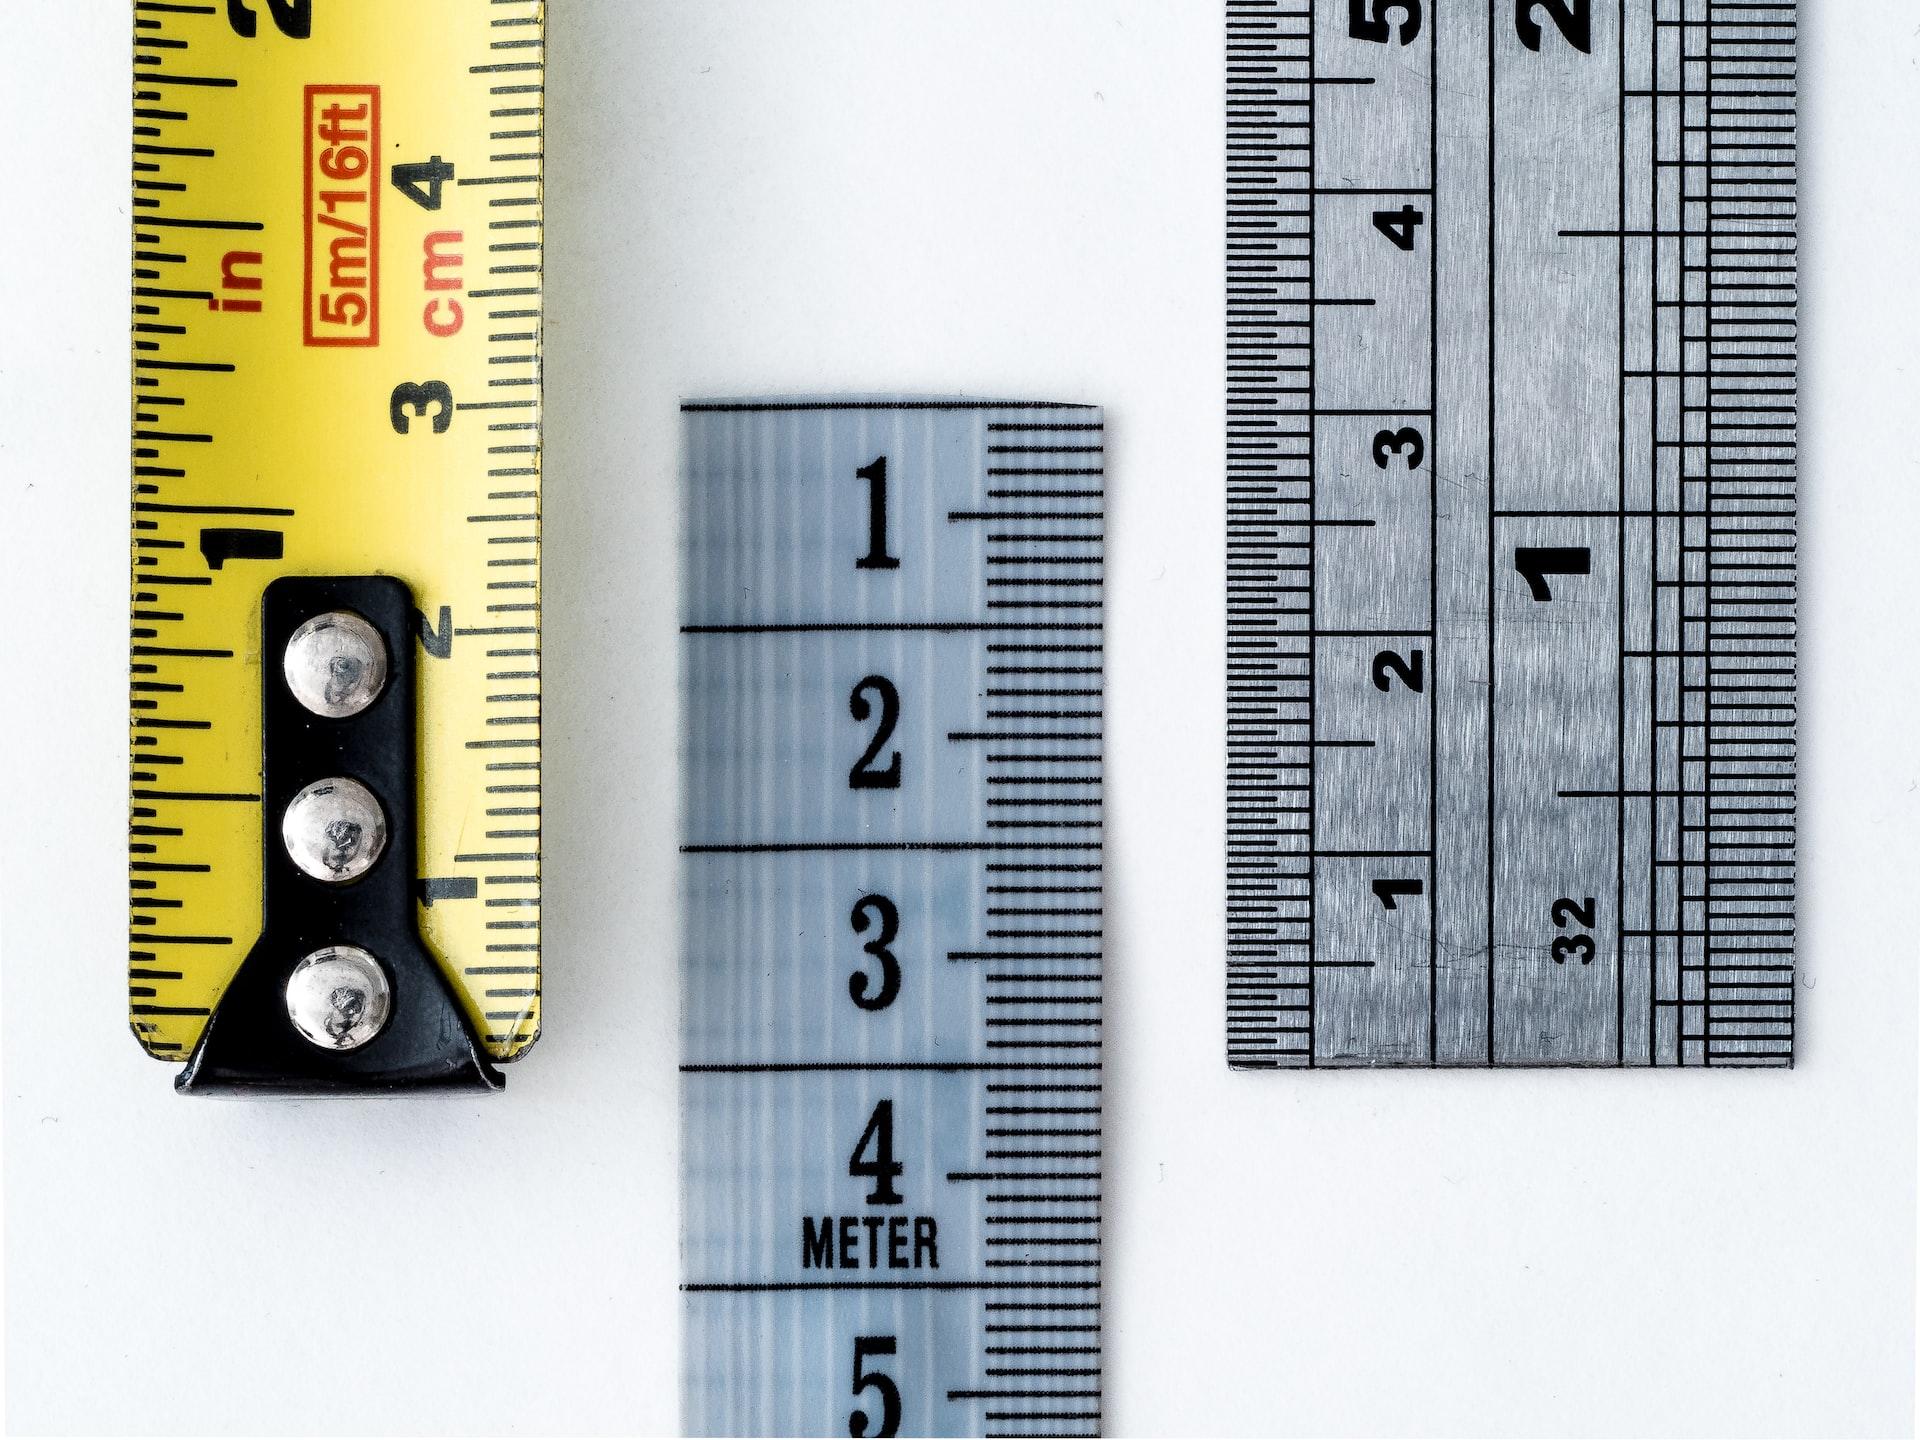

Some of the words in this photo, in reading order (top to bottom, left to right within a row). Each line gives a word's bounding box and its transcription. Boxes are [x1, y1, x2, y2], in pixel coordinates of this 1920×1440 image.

[1349, 0, 1422, 46] 5
[1515, 0, 1591, 54] 2
[391, 155, 455, 211] 4
[317, 103, 370, 327] 5m/16ft
[1372, 204, 1423, 251] 4
[209, 251, 262, 313] in
[423, 231, 464, 337] cm
[390, 380, 453, 434] 3
[1372, 426, 1424, 470] 3
[856, 456, 900, 569] 1
[200, 528, 284, 570] 1
[1515, 547, 1590, 601] 1
[1372, 650, 1423, 693] 2
[849, 675, 901, 789] 2
[1372, 879, 1423, 910] 1
[849, 894, 901, 1011] 3
[1551, 897, 1595, 965] 32
[849, 1100, 903, 1205] 4
[802, 1216, 939, 1269] METER
[849, 1336, 902, 1438] 5
